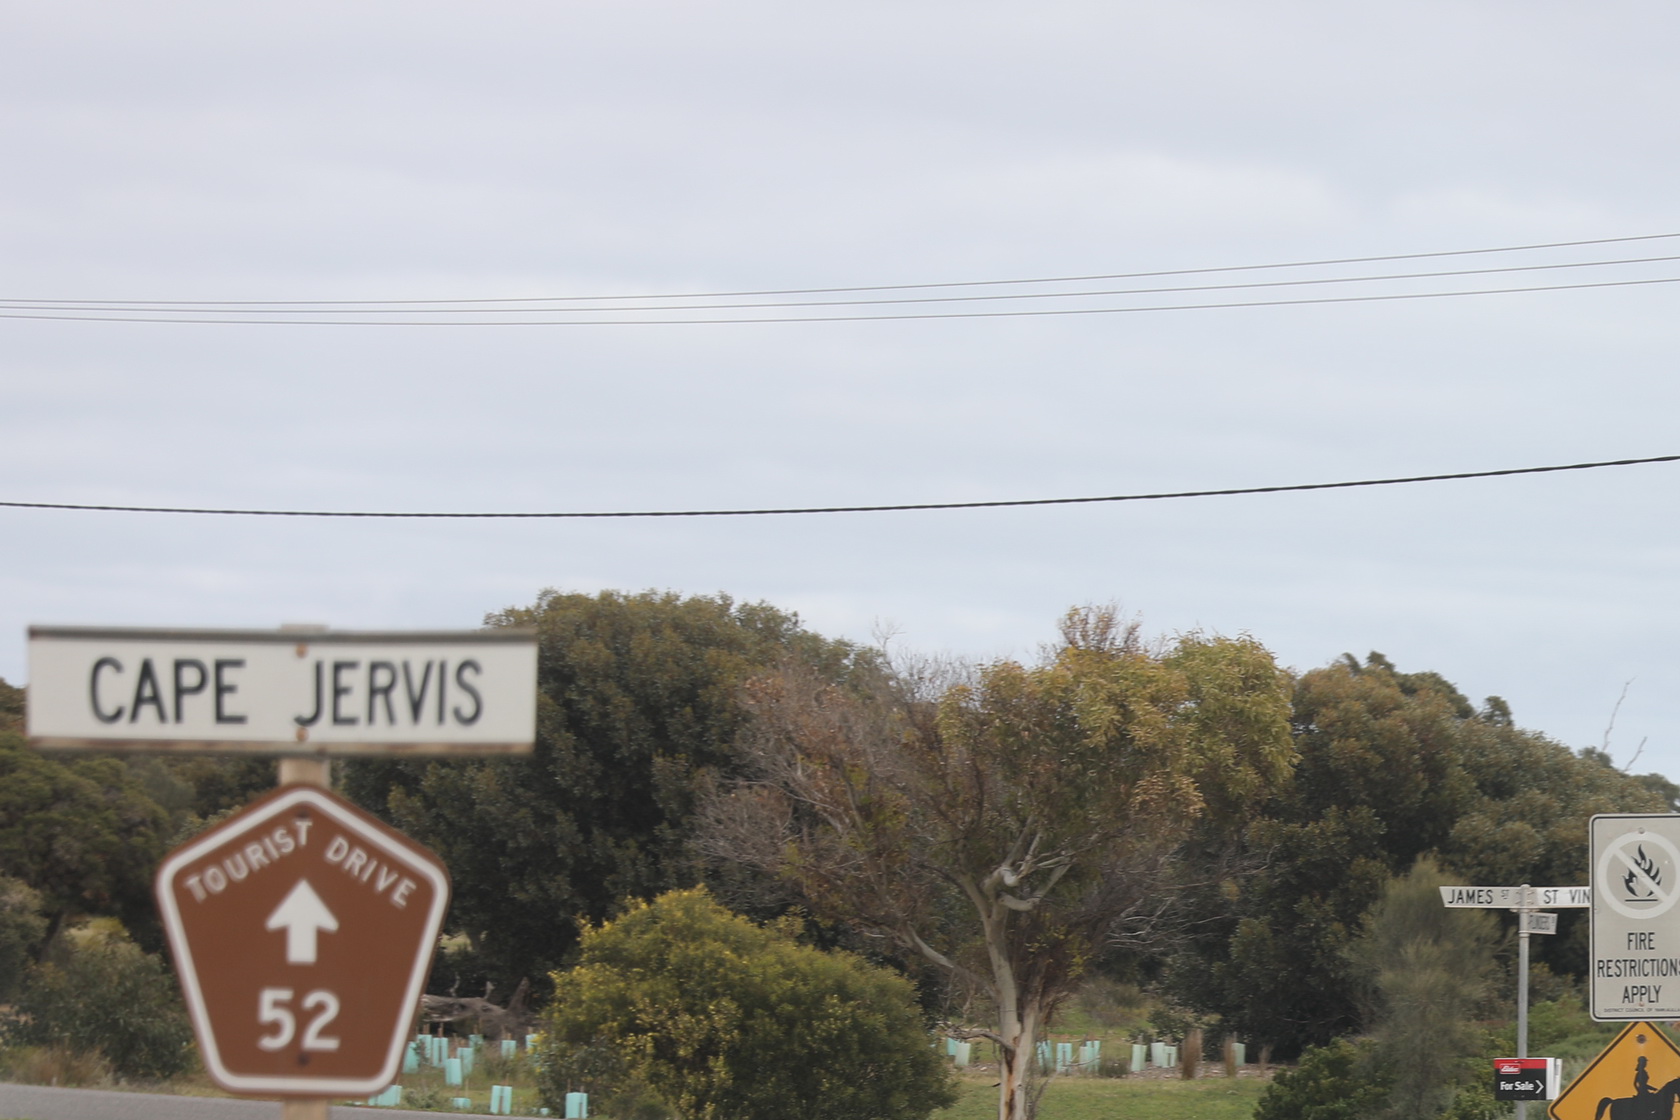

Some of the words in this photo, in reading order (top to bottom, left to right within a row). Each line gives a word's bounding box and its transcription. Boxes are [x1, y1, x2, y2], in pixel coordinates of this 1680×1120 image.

[90, 656, 248, 725] CAPE
[293, 658, 484, 728] JERVIS
[183, 819, 313, 902] TOURIST
[324, 836, 418, 909] DRIVE
[1447, 889, 1494, 904] JAMES
[1500, 889, 1510, 900] ST
[1543, 889, 1559, 904] ST
[1627, 932, 1656, 950] FIRE
[1622, 985, 1662, 1004] APPLY
[257, 986, 341, 1052] 52
[1500, 1081, 1514, 1090] For
[1514, 1081, 1535, 1090] Sale
